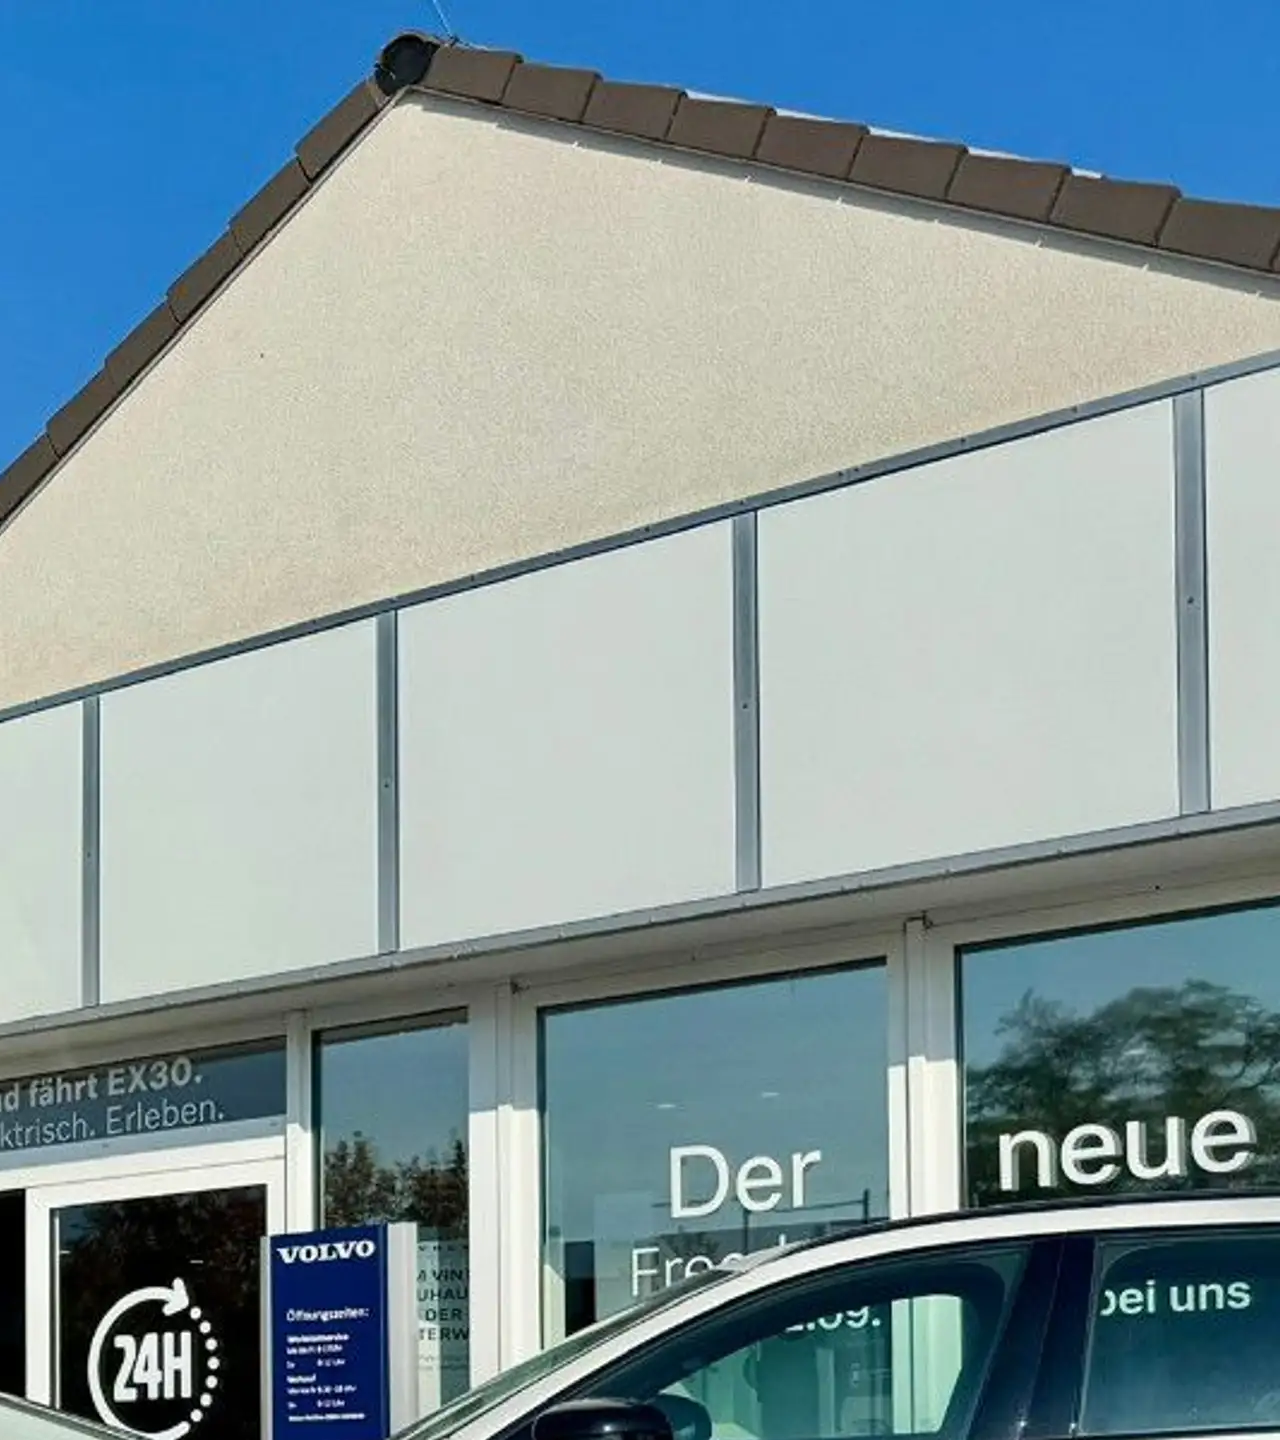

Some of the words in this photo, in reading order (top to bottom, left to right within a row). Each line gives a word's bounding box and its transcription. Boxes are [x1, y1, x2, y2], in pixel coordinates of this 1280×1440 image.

[29, 1073, 98, 1112] fährt
[107, 1056, 203, 1096] EX30.
[106, 1097, 225, 1136] Erleben.
[670, 1144, 822, 1218] Der
[998, 1110, 1257, 1192] neue
[277, 1240, 376, 1264] VOLVO
[1169, 1281, 1253, 1313] uns
[113, 1330, 192, 1402] 24H
